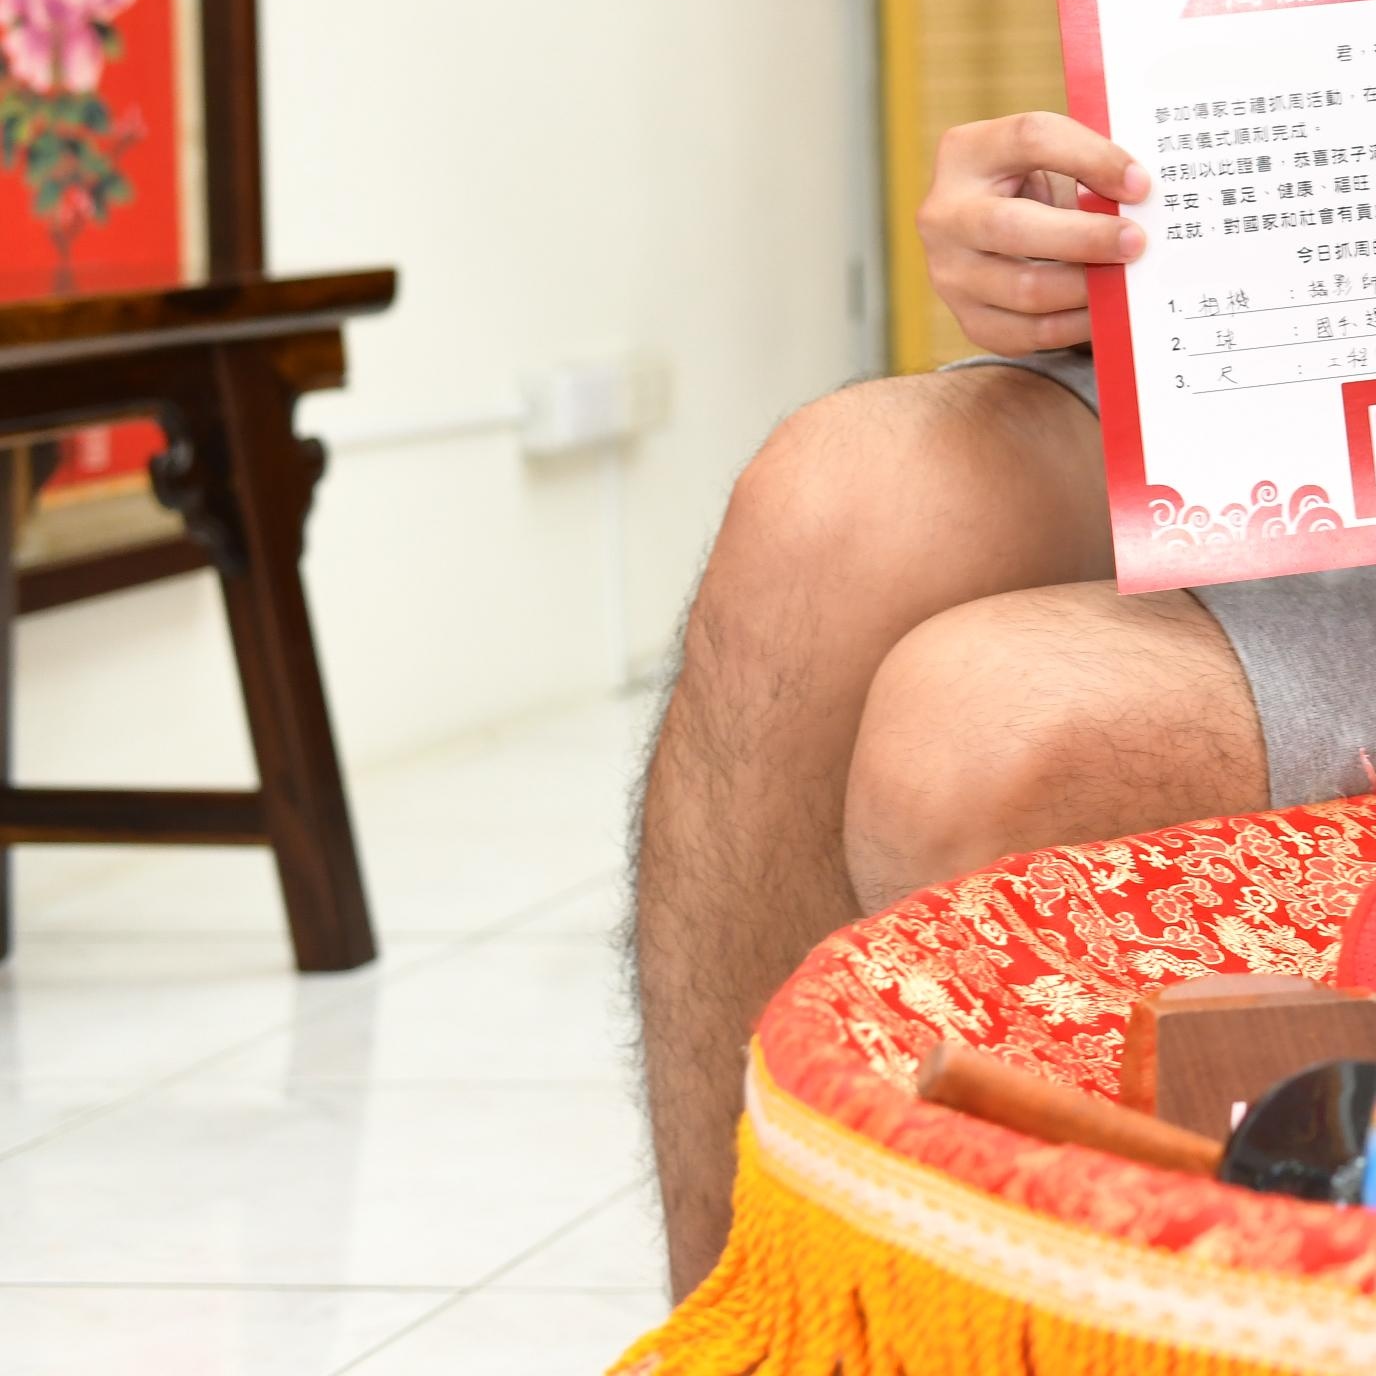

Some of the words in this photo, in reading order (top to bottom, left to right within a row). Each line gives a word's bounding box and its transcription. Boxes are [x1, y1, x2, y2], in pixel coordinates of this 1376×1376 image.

[1167, 299, 1183, 313] 1.
[1171, 337, 1187, 351] 2.
[1175, 376, 1190, 389] 3.
